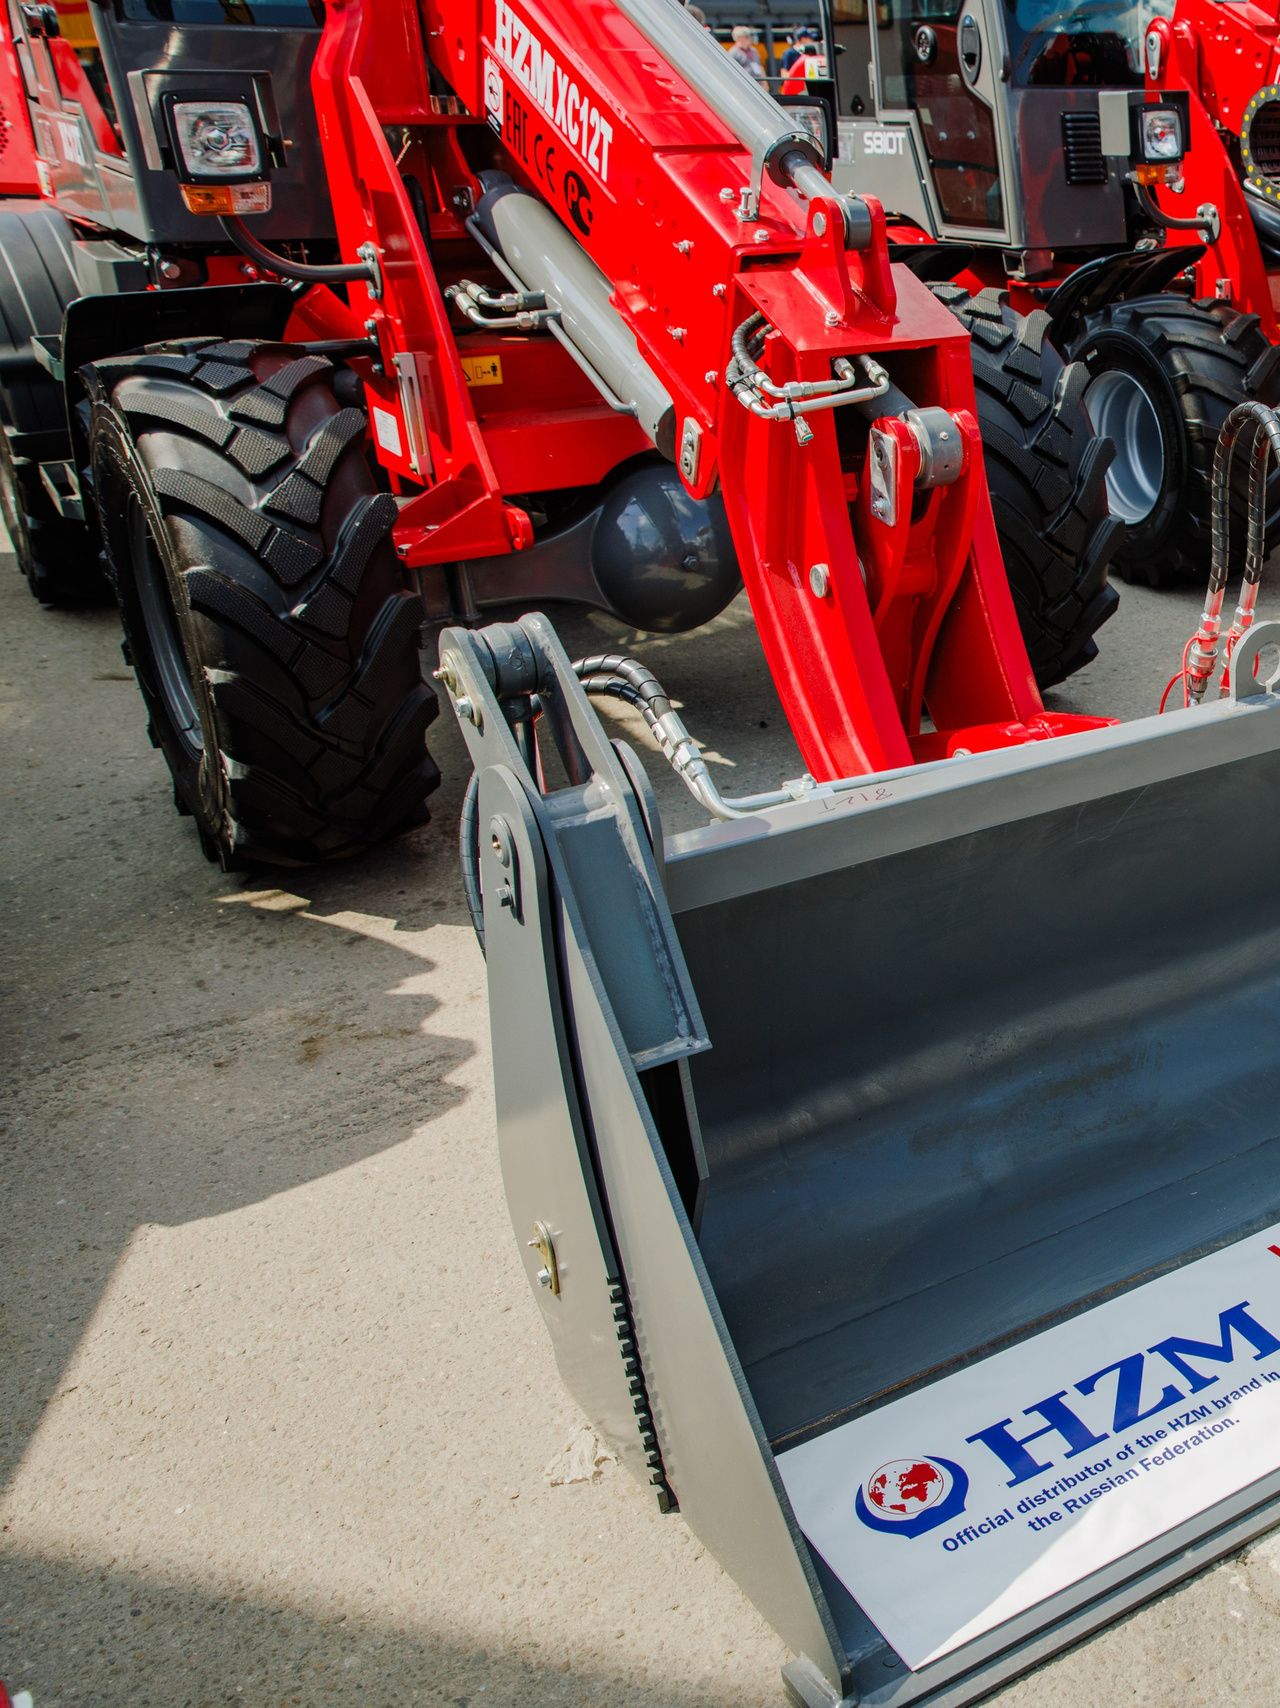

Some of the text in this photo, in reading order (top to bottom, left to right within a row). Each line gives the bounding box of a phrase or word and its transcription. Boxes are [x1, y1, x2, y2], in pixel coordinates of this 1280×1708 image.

[863, 131, 906, 156] S810T
[942, 1371, 1280, 1551] Official distributor of the HZM brand in
[1028, 1418, 1241, 1532] the Russian Federation.
